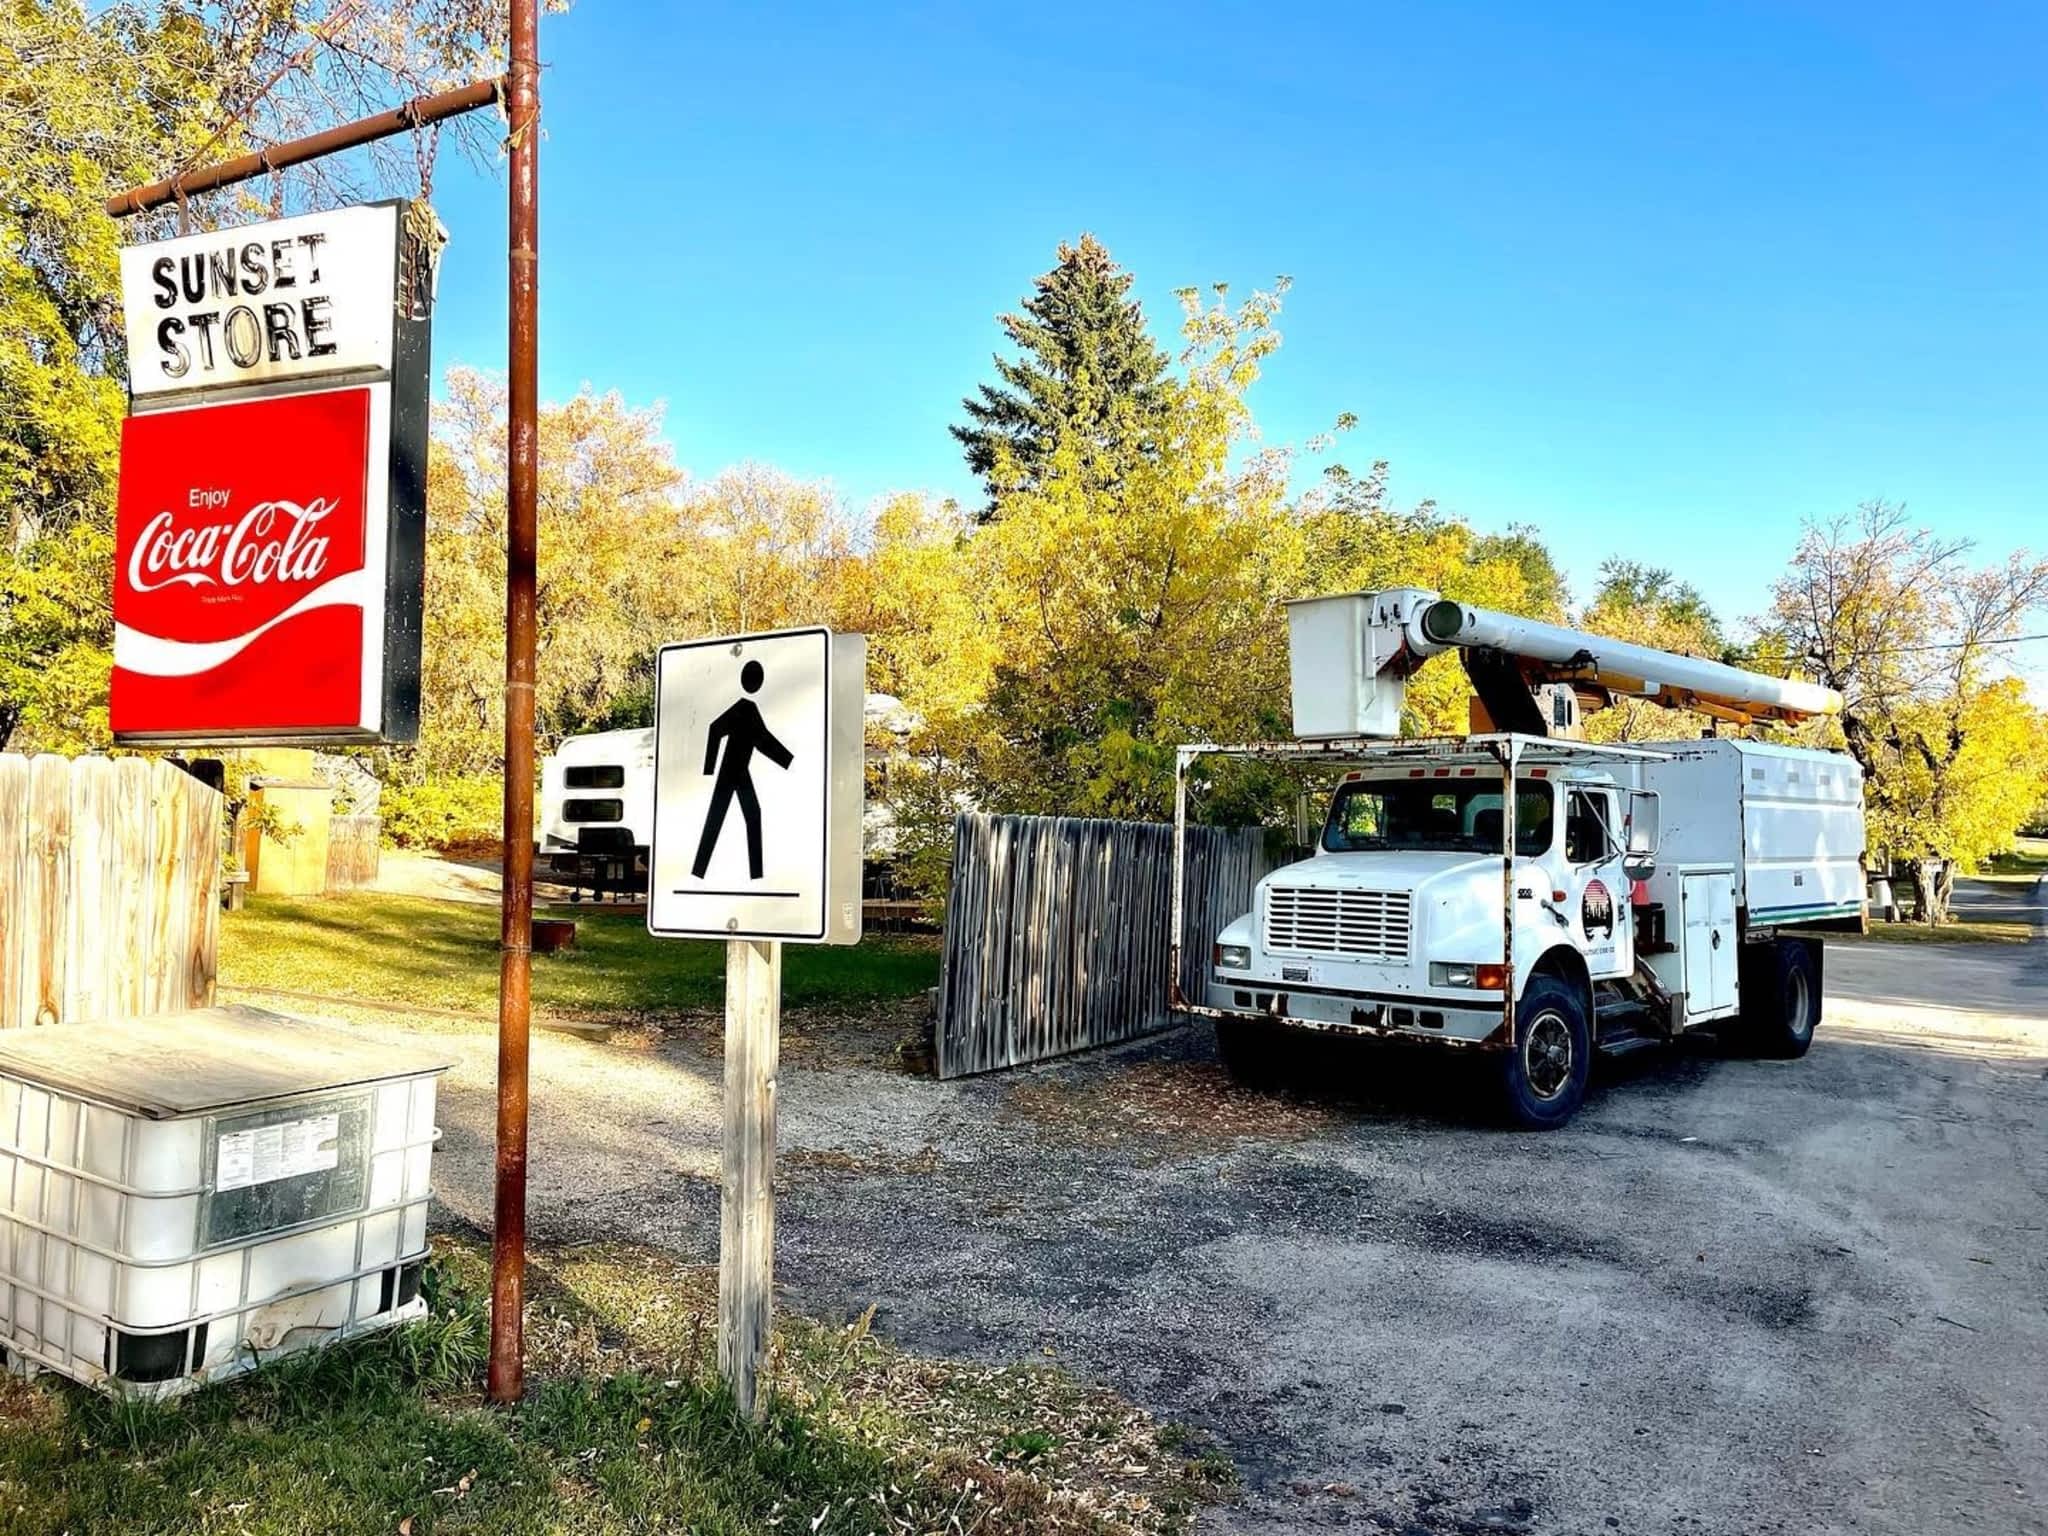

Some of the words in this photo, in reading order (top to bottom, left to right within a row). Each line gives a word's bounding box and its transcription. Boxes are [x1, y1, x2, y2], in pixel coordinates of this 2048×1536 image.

[152, 232, 326, 309] SUNSET
[157, 295, 337, 378] STORE
[189, 488, 230, 509] Enjoy
[128, 497, 340, 593] Coca-Cola
